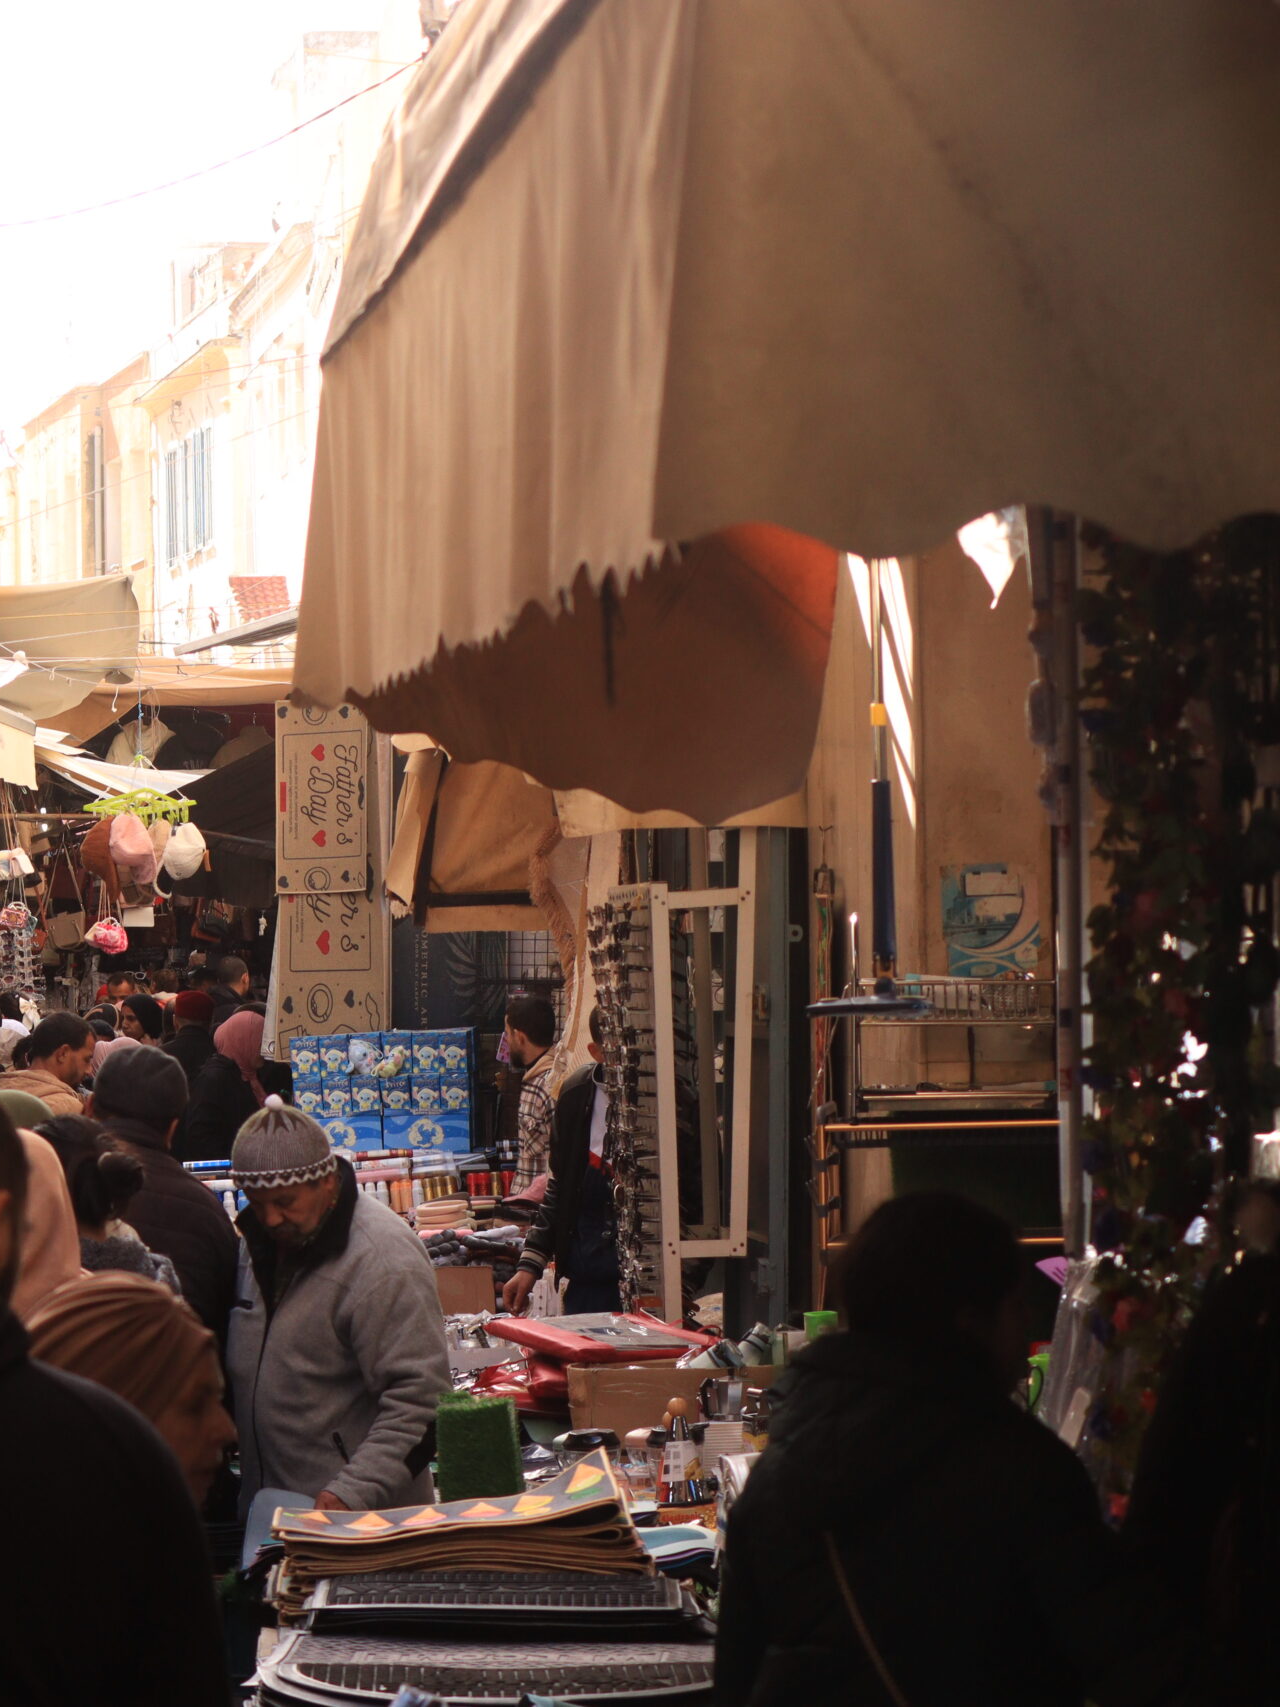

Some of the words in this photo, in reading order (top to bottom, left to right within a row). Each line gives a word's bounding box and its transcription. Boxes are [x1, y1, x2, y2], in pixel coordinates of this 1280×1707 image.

[301, 766, 335, 826] Day
[333, 744, 359, 846] Father's
[420, 929, 428, 998] OMETRIC
